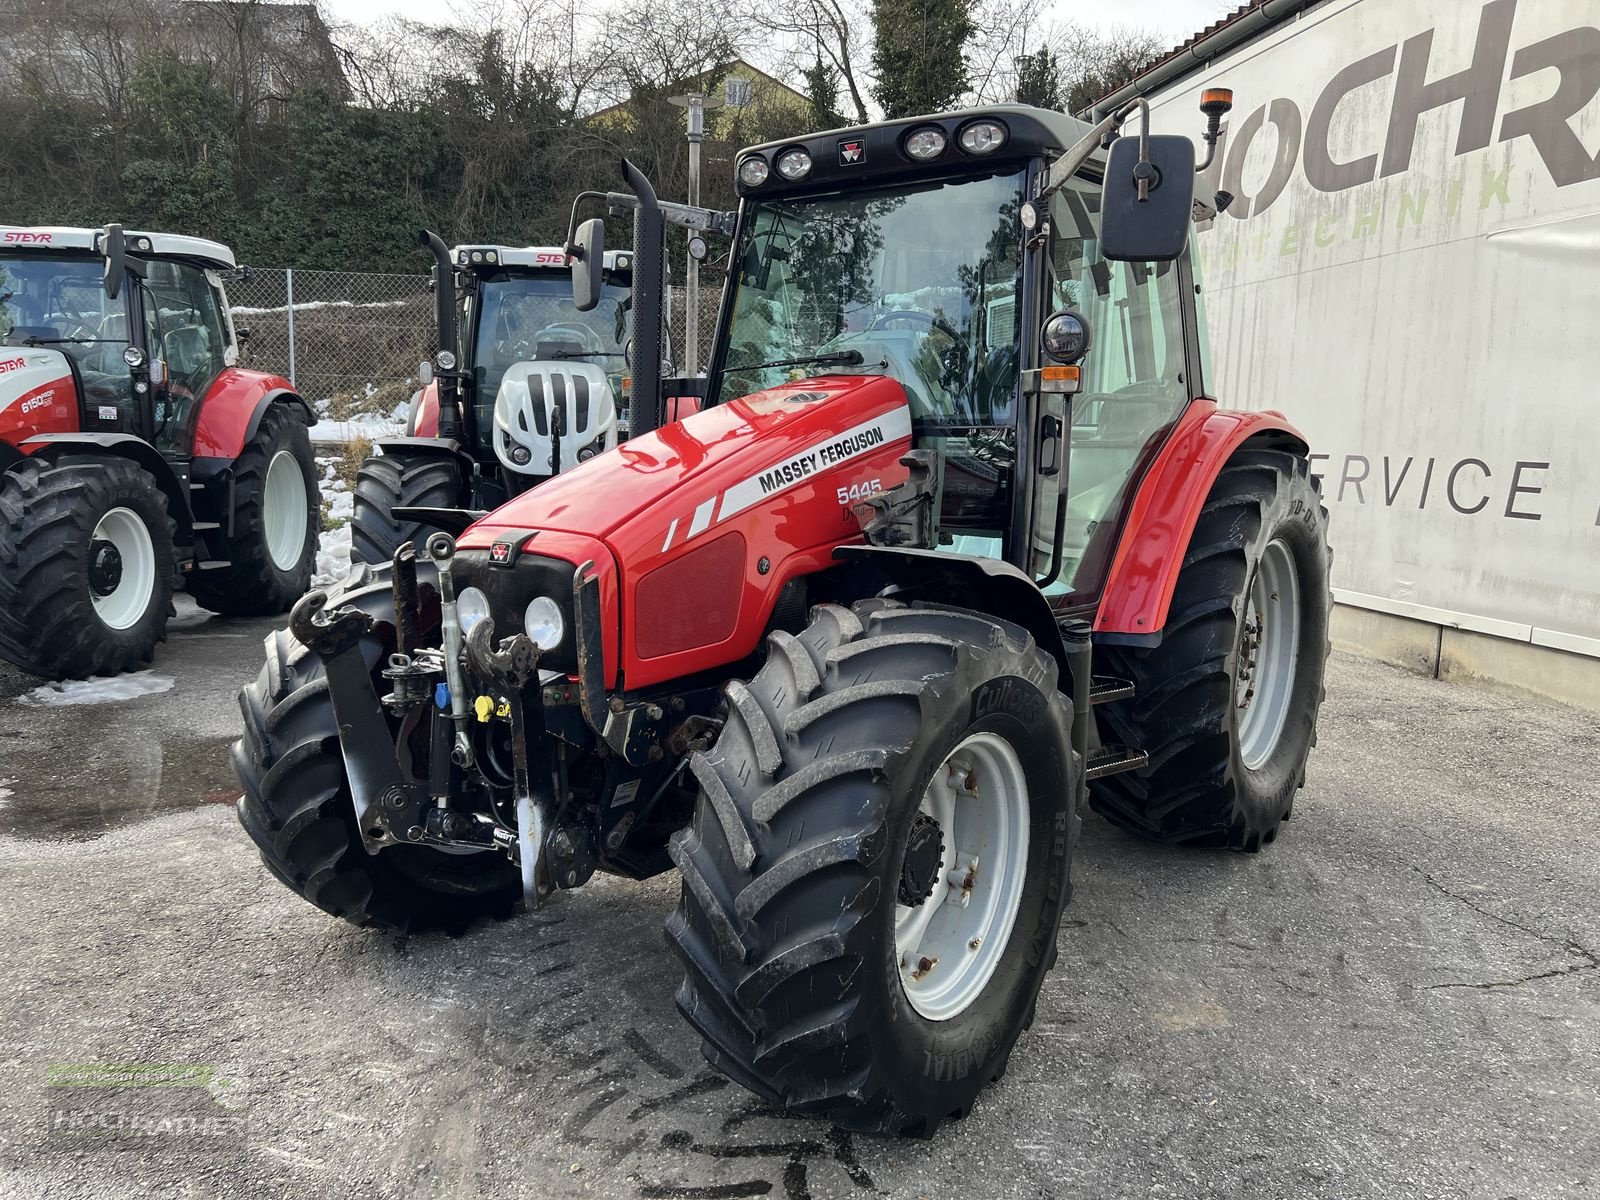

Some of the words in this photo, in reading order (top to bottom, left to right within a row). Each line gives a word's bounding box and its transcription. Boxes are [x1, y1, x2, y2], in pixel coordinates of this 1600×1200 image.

[4, 231, 52, 244] STEYR
[21, 394, 43, 414] 6150
[758, 453, 818, 494] MASSEY
[819, 426, 884, 466] FERGUSON
[836, 478, 882, 505] 5445
